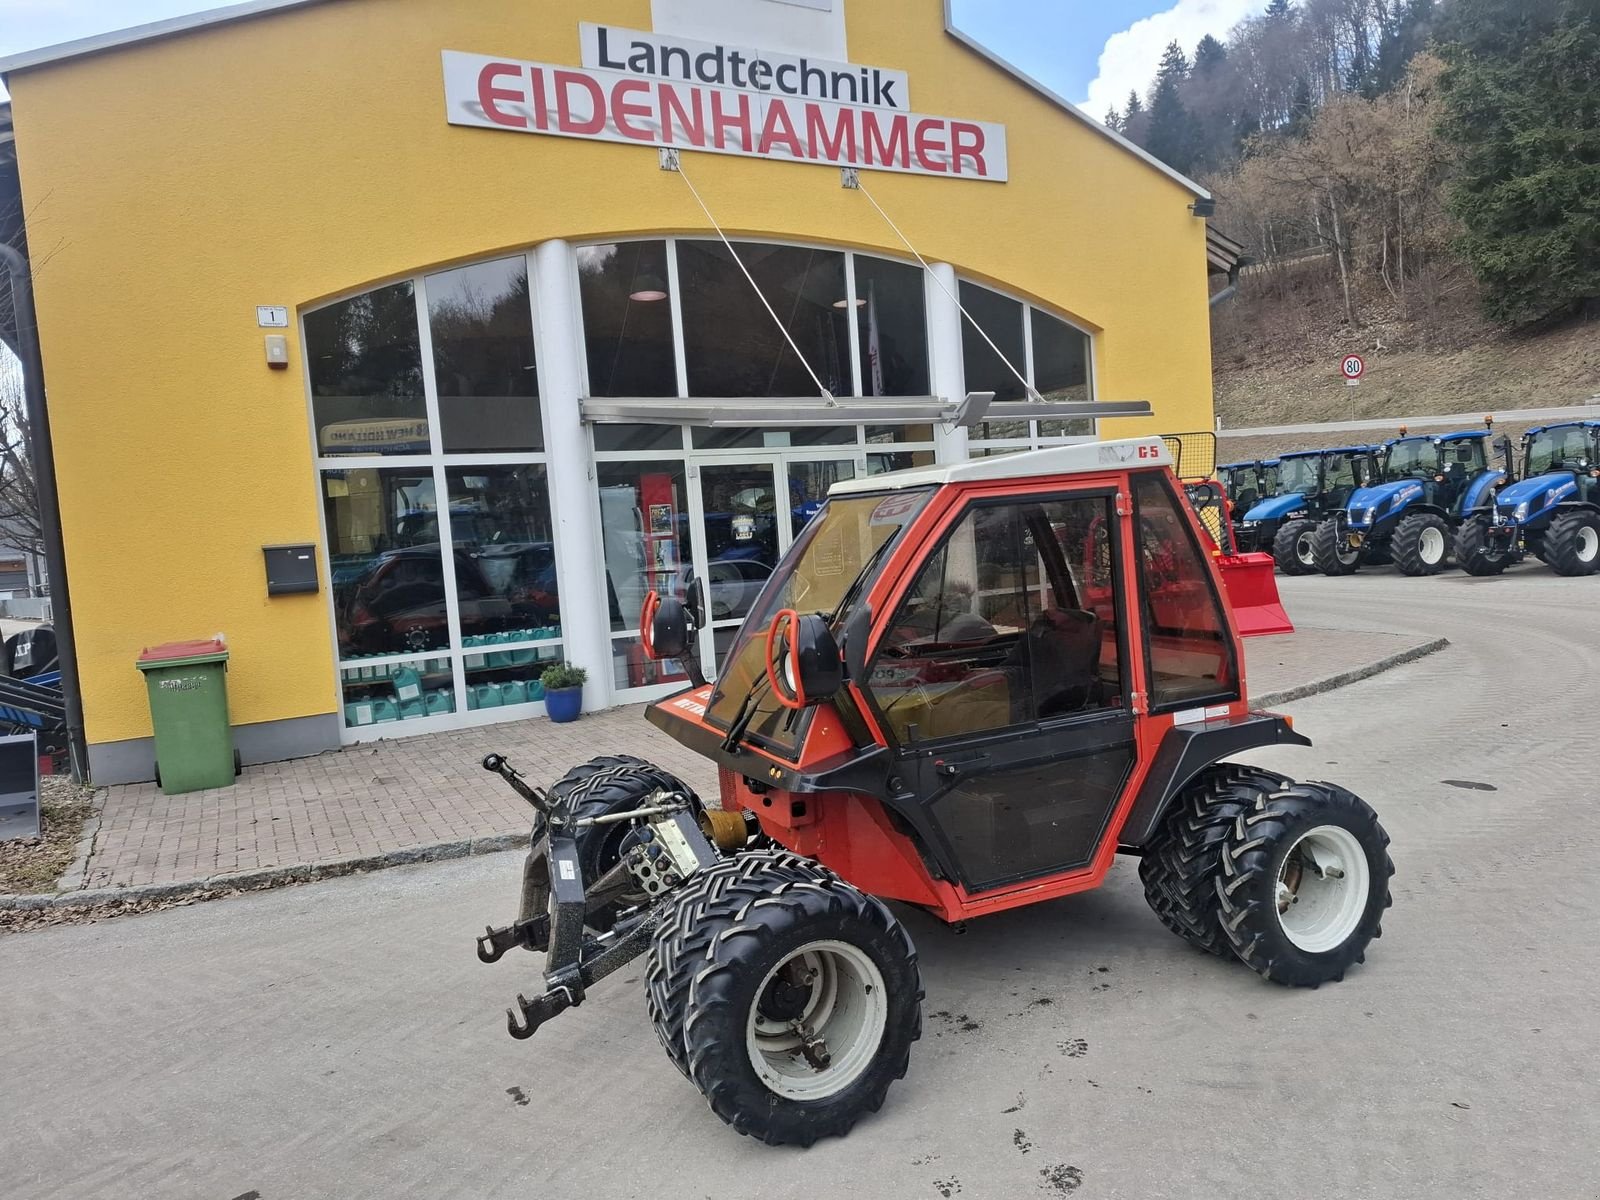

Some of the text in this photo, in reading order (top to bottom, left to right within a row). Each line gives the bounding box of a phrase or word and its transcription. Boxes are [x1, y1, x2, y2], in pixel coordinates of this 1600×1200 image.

[598, 27, 897, 107] Landtechnik
[478, 63, 986, 176] EIDENHAMMER
[269, 310, 275, 322] 1
[1346, 360, 1360, 373] 80
